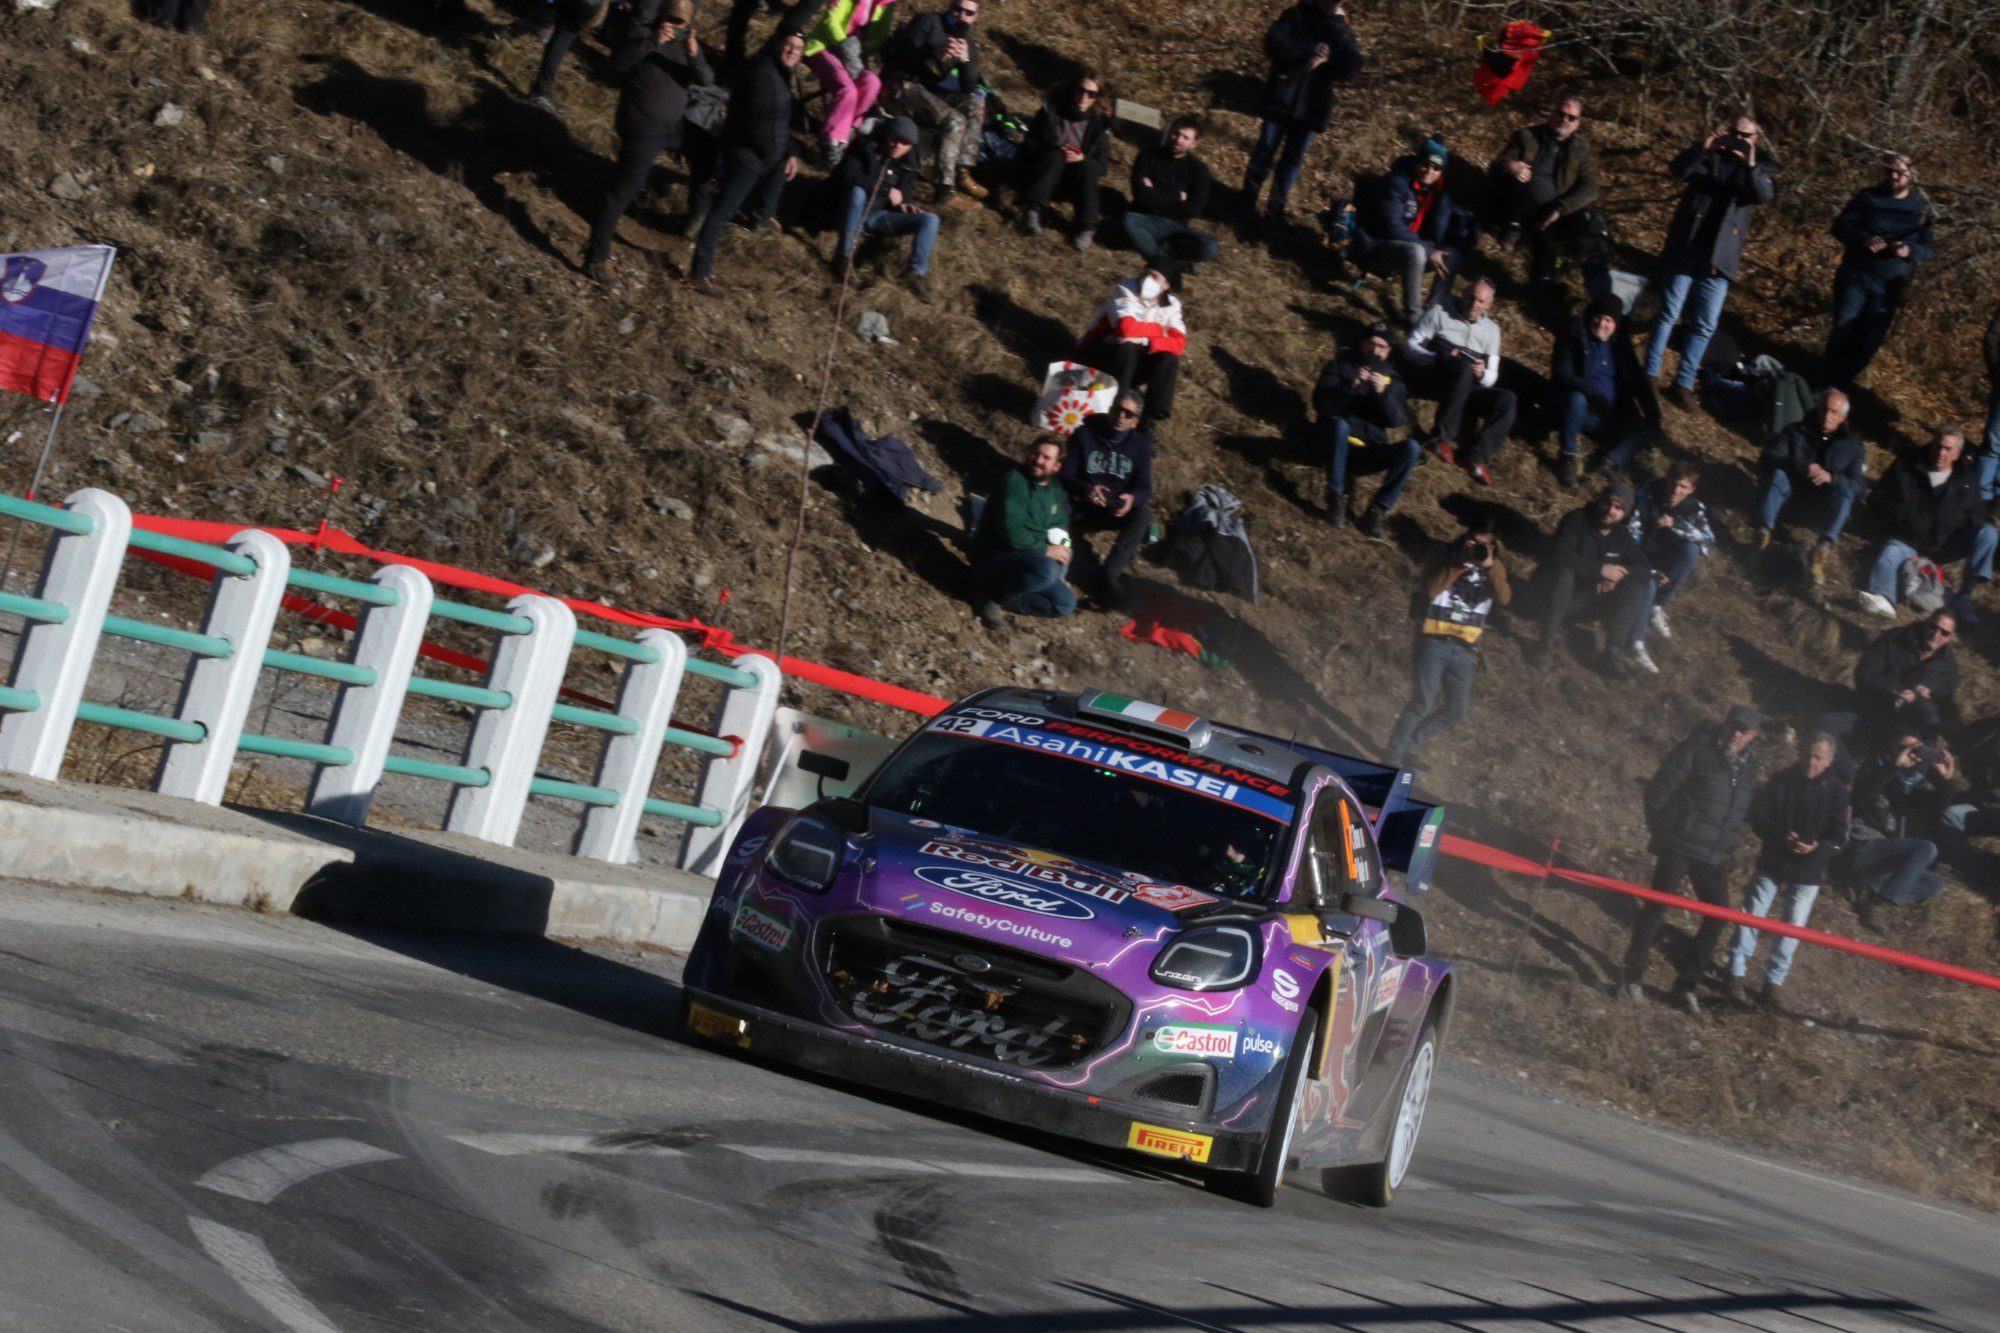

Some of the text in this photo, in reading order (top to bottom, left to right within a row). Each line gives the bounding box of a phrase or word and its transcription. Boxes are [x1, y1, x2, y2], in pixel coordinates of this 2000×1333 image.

[935, 716, 978, 734] 42
[957, 707, 1291, 797] FORD PERFORMANCE
[919, 841, 1030, 874] Red
[1025, 865, 1130, 905] Bull
[942, 872, 1066, 912] Ford
[741, 913, 788, 948] Castrol
[929, 901, 1073, 948] SafetyCulture
[1175, 1030, 1274, 1055] Castrol pulse
[1136, 1128, 1205, 1158] PIRELLI
